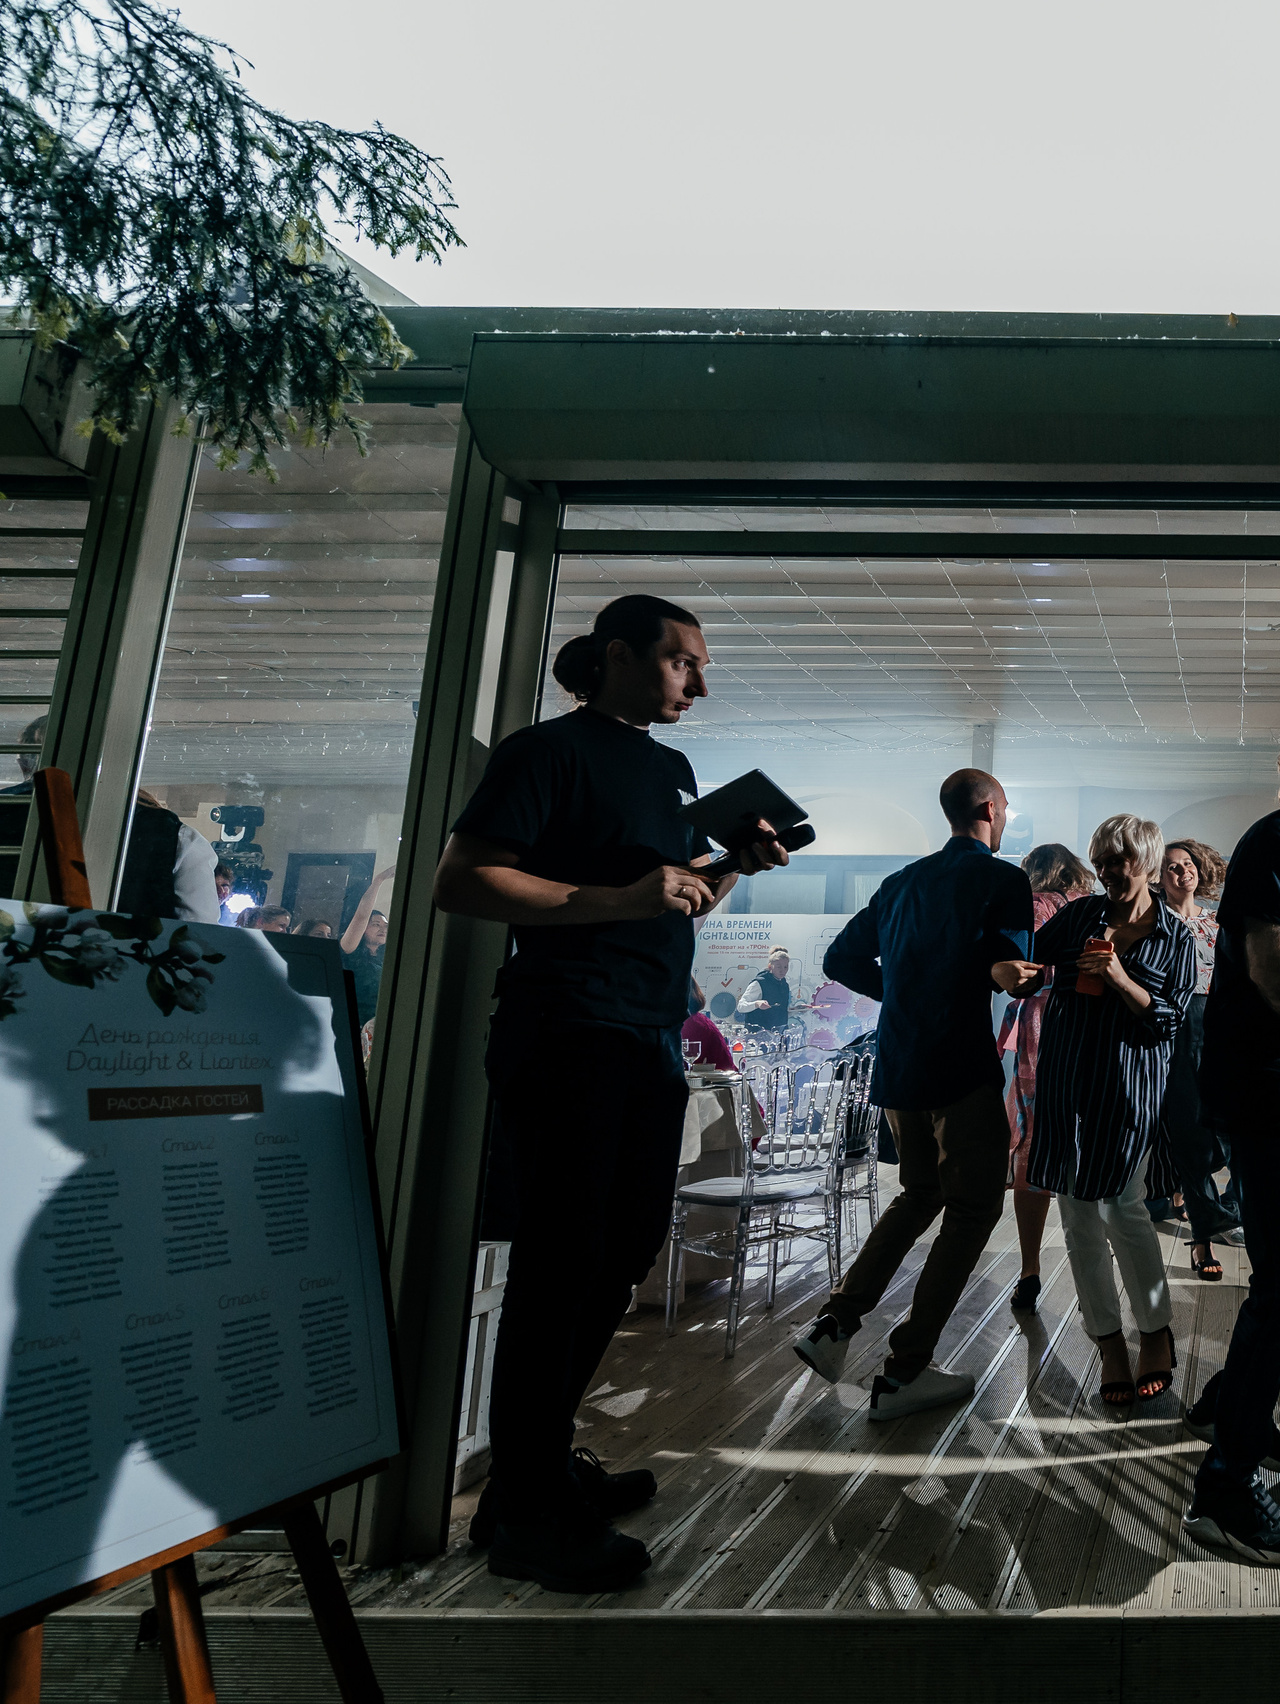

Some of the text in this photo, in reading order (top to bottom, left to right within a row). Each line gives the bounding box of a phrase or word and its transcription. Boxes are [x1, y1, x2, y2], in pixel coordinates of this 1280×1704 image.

[702, 920, 773, 929] ИНА ВРЕМЕНИ
[699, 931, 771, 941] IGHT&LIONTEX
[78, 1023, 262, 1050] День рождения
[66, 1050, 275, 1076] Daylight & Liontex
[107, 1092, 249, 1111] РАССАДКА ГОСТЕЙ
[162, 1137, 215, 1152] Стол 2
[255, 1132, 291, 1145] Стол
[299, 1277, 334, 1292] Стол
[218, 1294, 260, 1309] Стол
[125, 1303, 185, 1330] Стол 5
